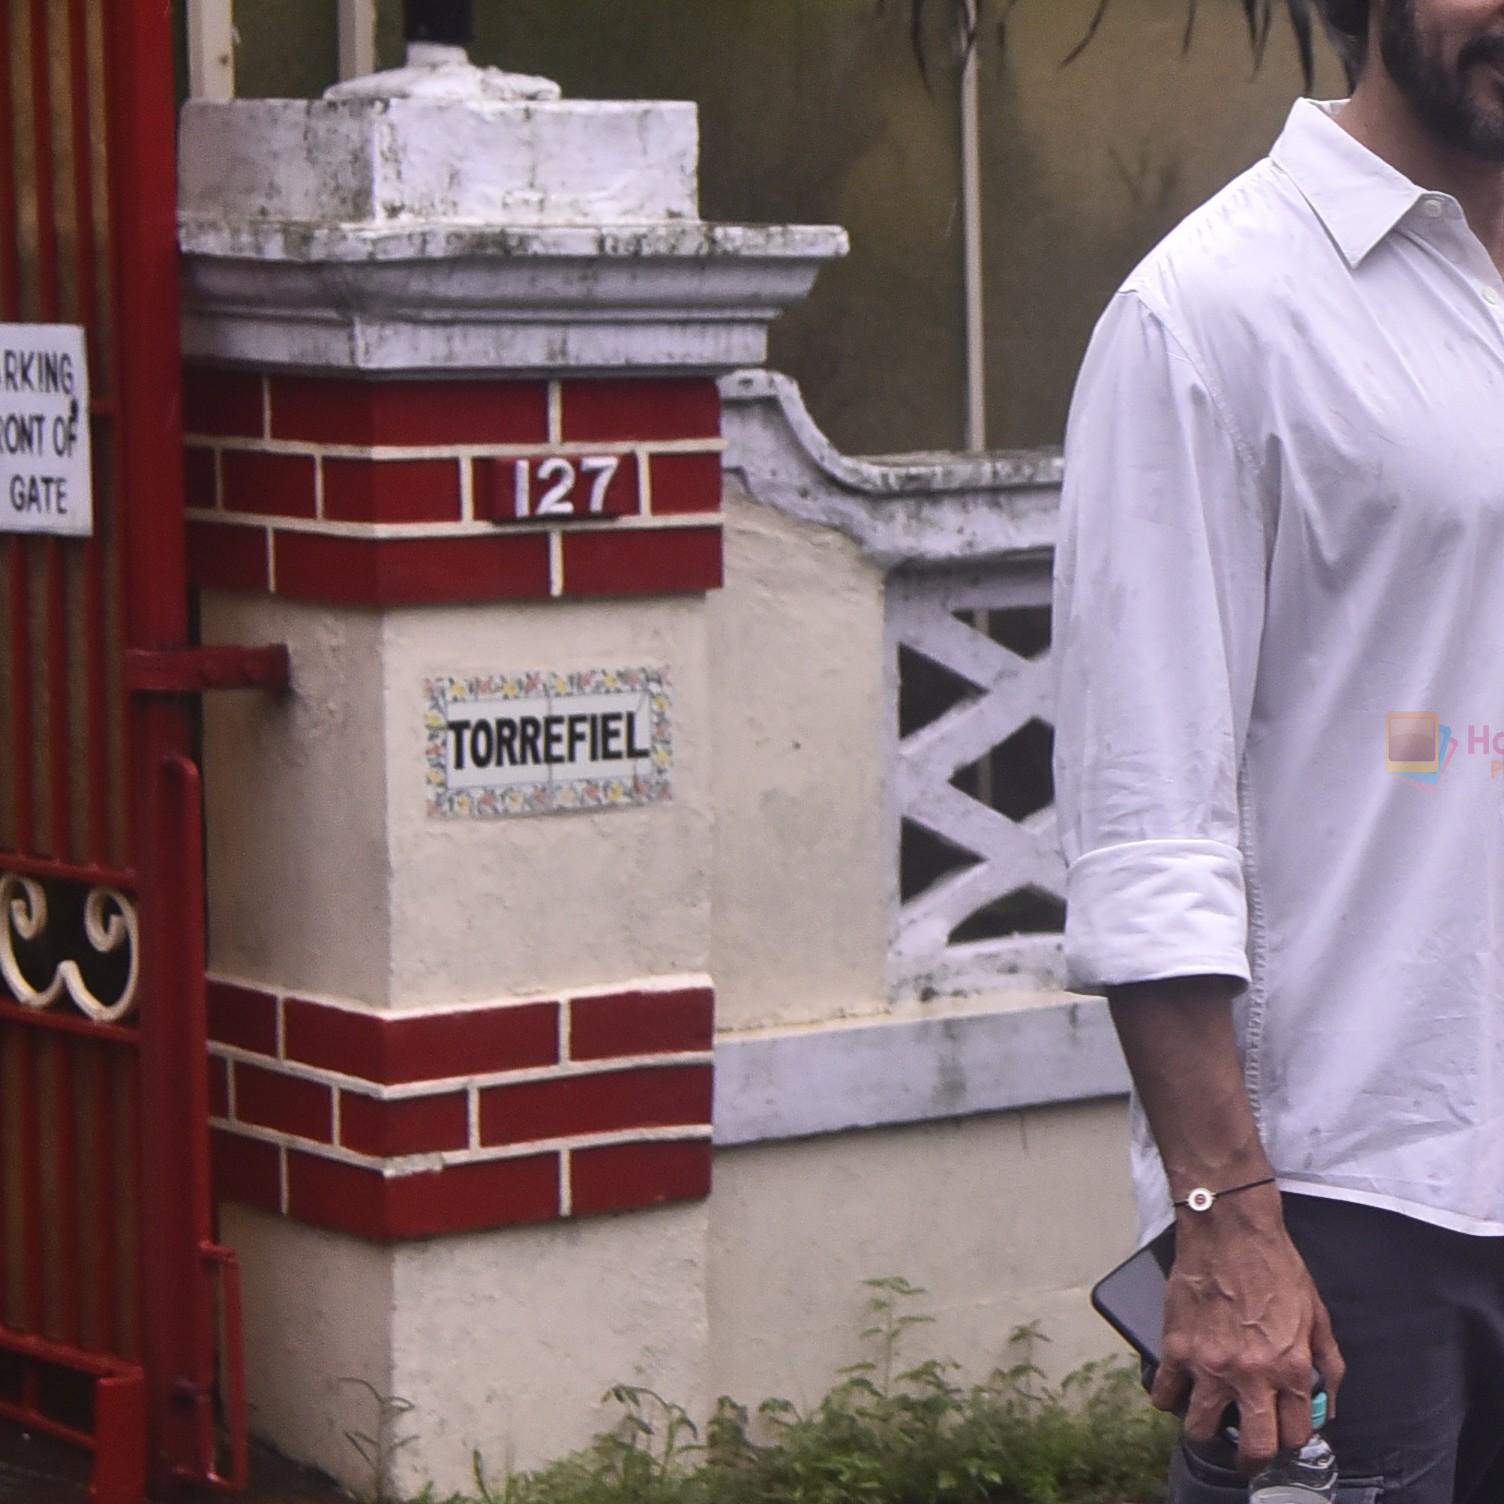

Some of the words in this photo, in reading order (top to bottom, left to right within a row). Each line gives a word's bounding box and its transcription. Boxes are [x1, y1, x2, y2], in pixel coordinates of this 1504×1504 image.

[0, 349, 74, 395] RKING
[0, 413, 45, 456] ONT
[53, 414, 78, 459] OF
[10, 473, 67, 514] GATE
[515, 456, 618, 517] 127
[448, 710, 650, 770] TORREFIEL
